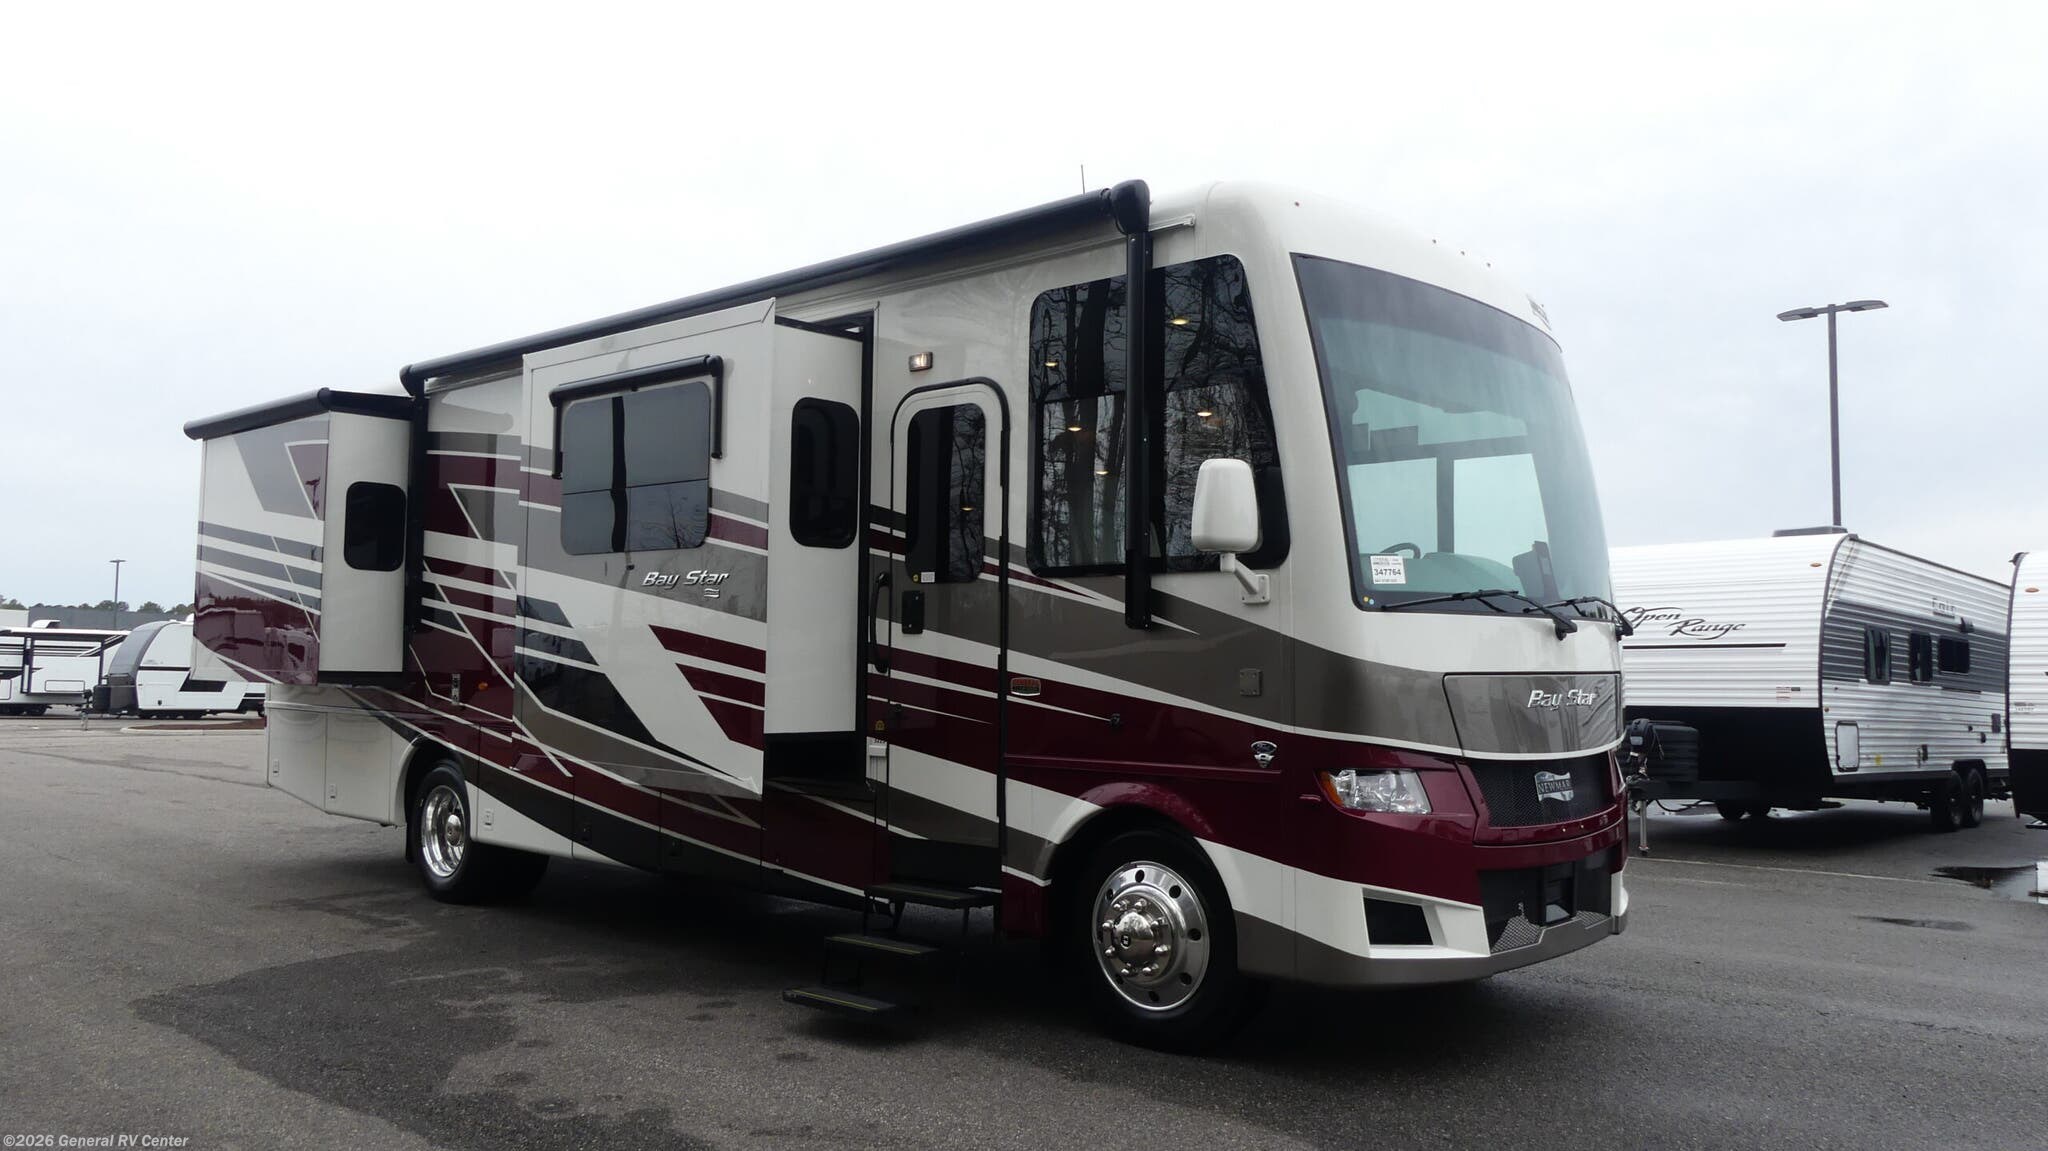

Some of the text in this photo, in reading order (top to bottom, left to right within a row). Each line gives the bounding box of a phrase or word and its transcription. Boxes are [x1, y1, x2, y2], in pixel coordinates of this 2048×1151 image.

[642, 569, 730, 589] Bay Star
[1622, 606, 1684, 629] Open
[1664, 618, 1747, 641] Range
[1527, 688, 1598, 711] Bay Star
[1538, 779, 1571, 794] NEWMAR
